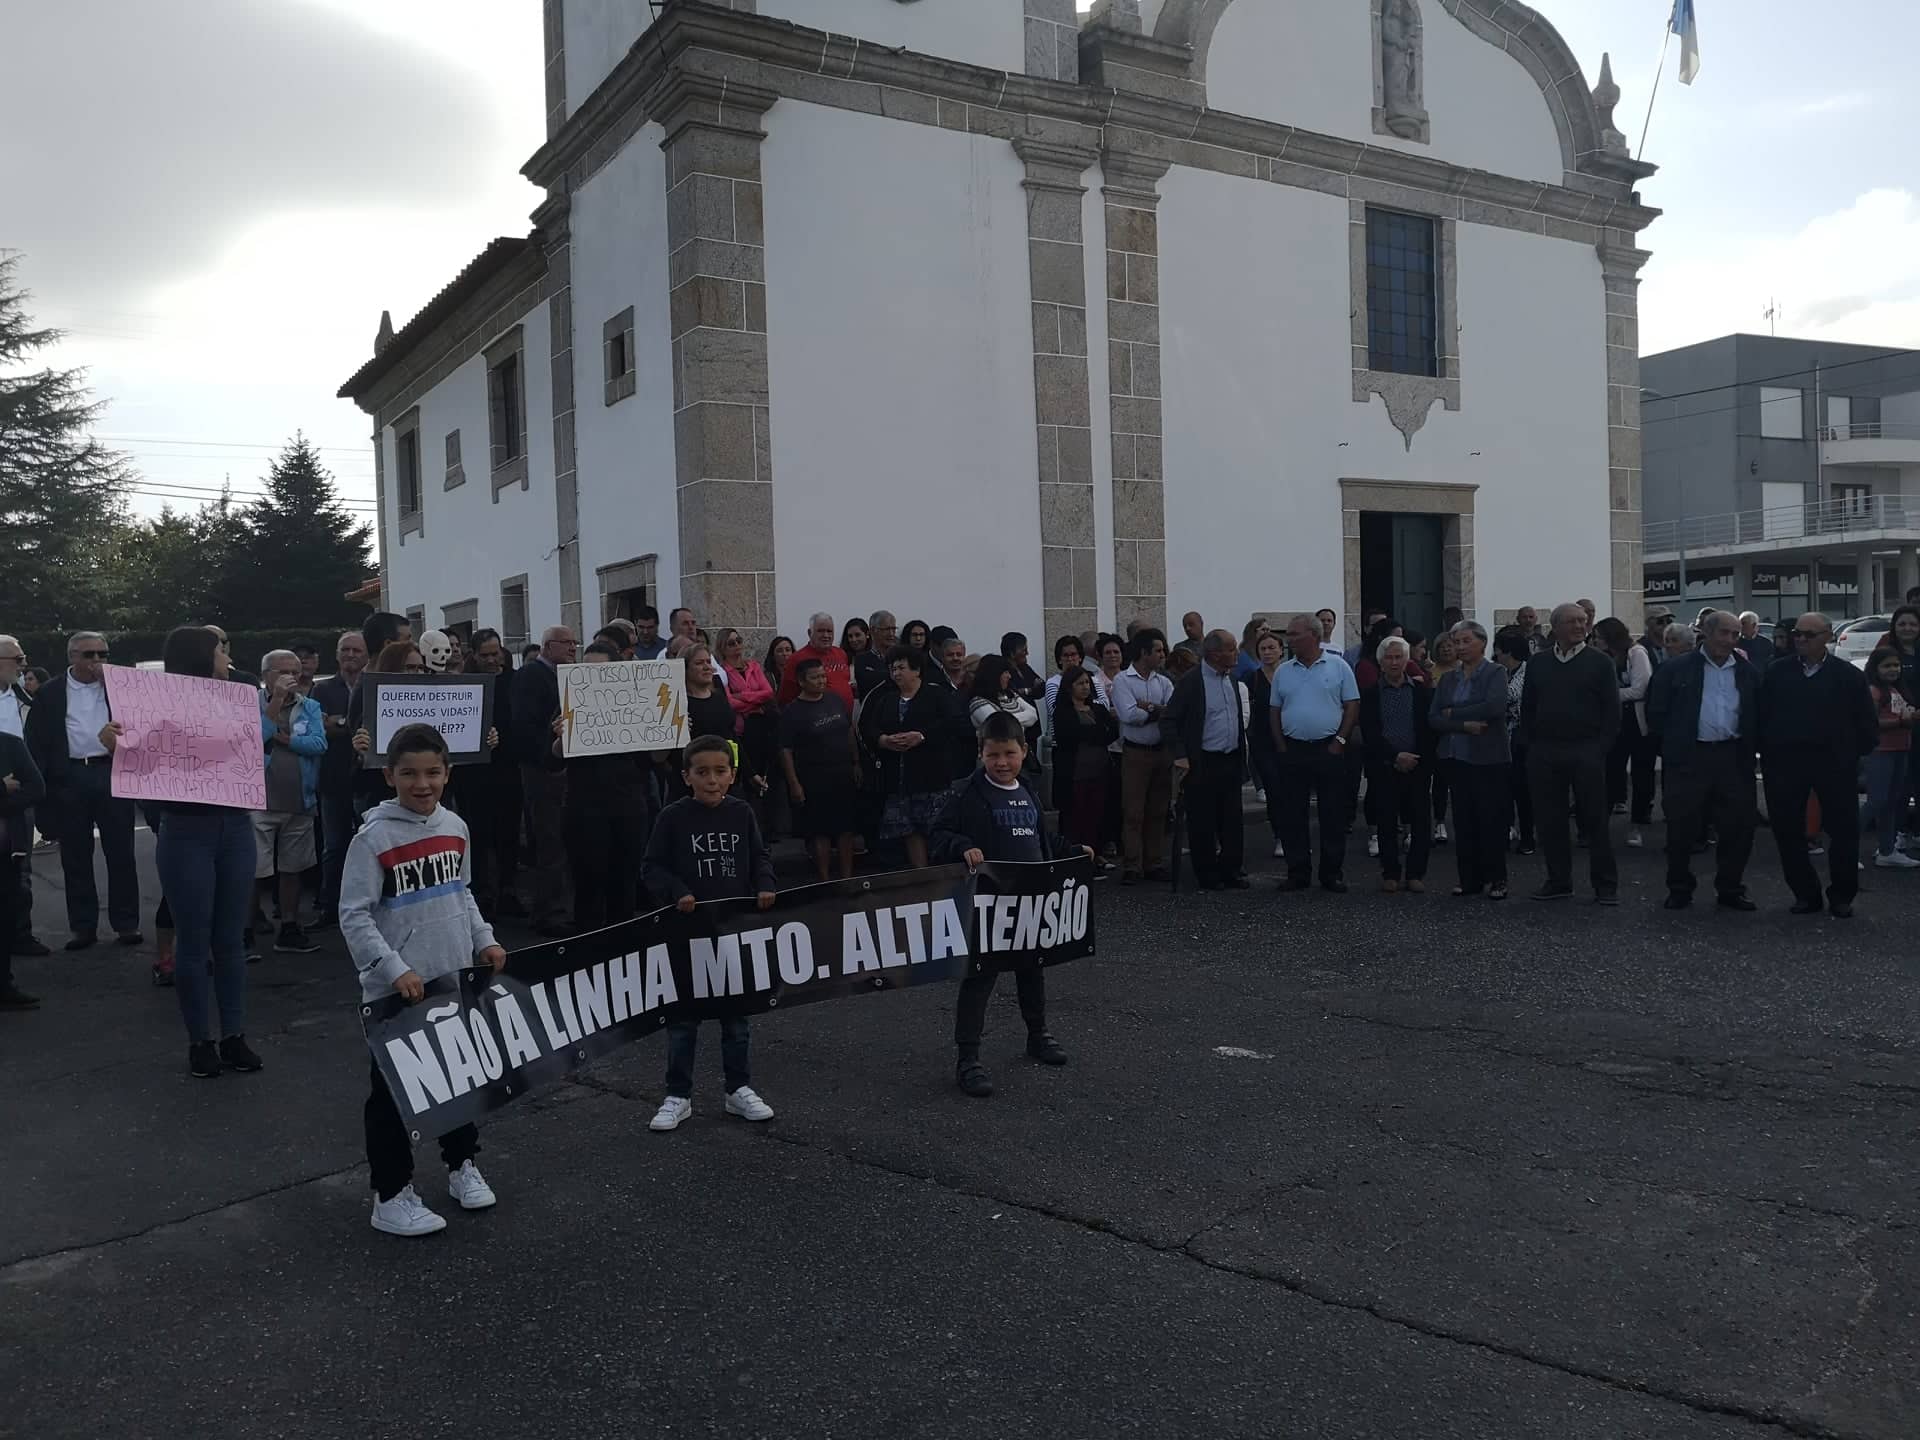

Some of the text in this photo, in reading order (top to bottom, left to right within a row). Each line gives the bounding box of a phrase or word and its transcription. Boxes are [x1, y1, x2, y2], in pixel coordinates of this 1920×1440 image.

[381, 691, 473, 702] QUEREM DESTRUIR
[593, 687, 650, 706] mais
[381, 708, 394, 718] AS
[396, 707, 436, 718] NOSSAS
[691, 832, 740, 854] KEEP
[697, 858, 717, 879] IT
[385, 877, 1090, 1115] NÃO À LINHA MTO. ALTA TENSÃO
